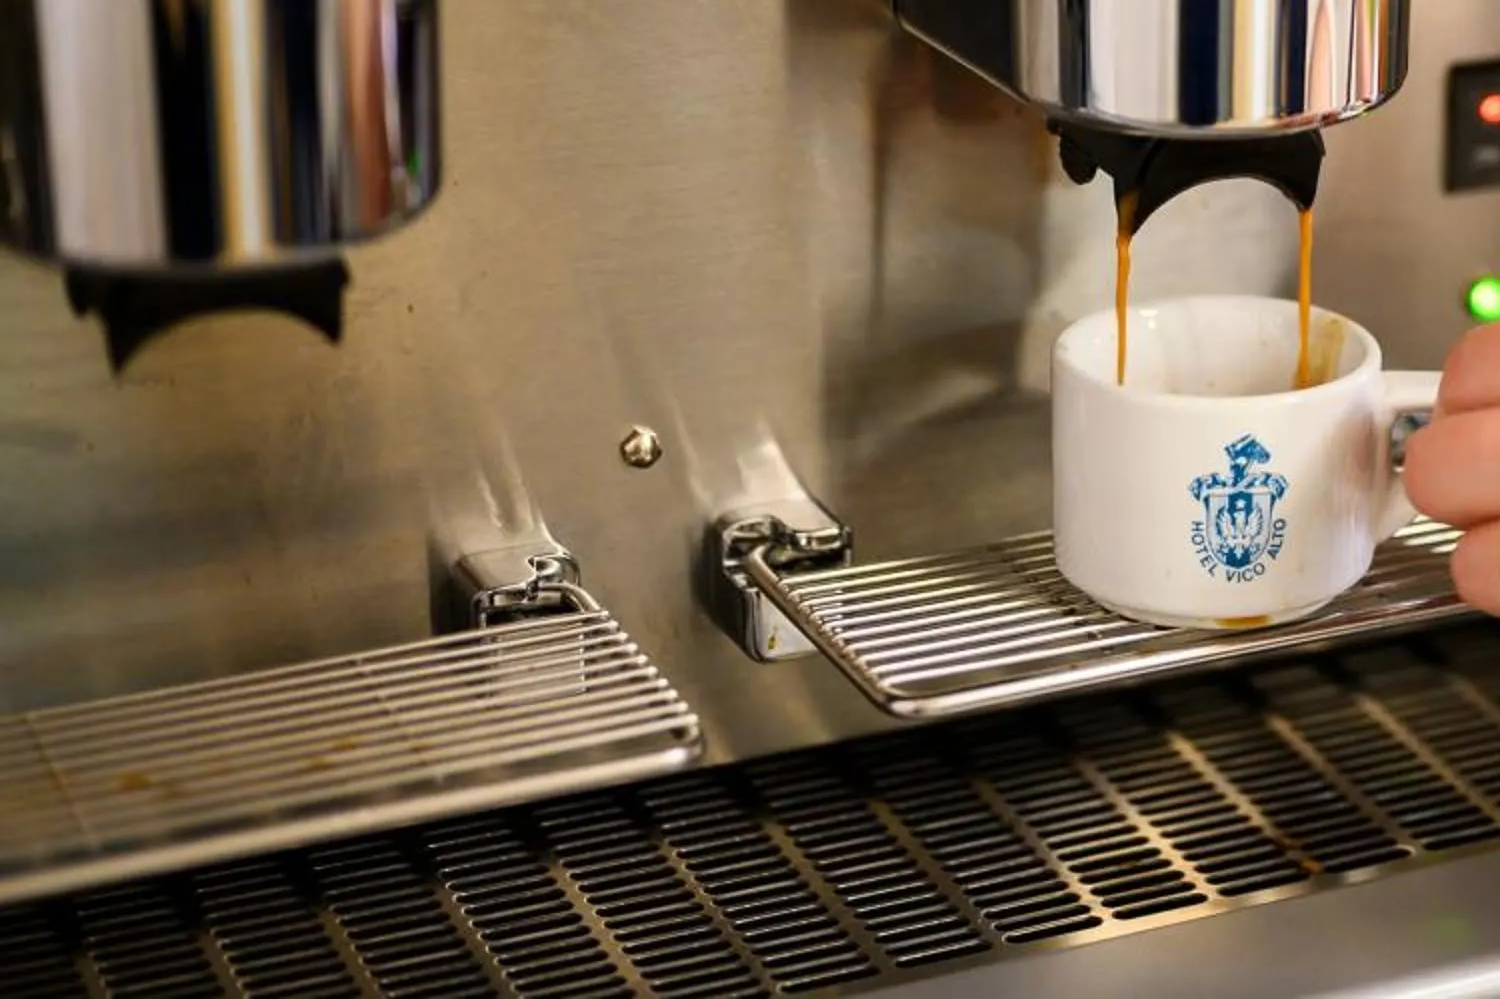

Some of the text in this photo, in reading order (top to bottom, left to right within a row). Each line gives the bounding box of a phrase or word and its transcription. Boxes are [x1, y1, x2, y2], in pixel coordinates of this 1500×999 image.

[1191, 518, 1287, 583] HOTEL VICO ALTO
